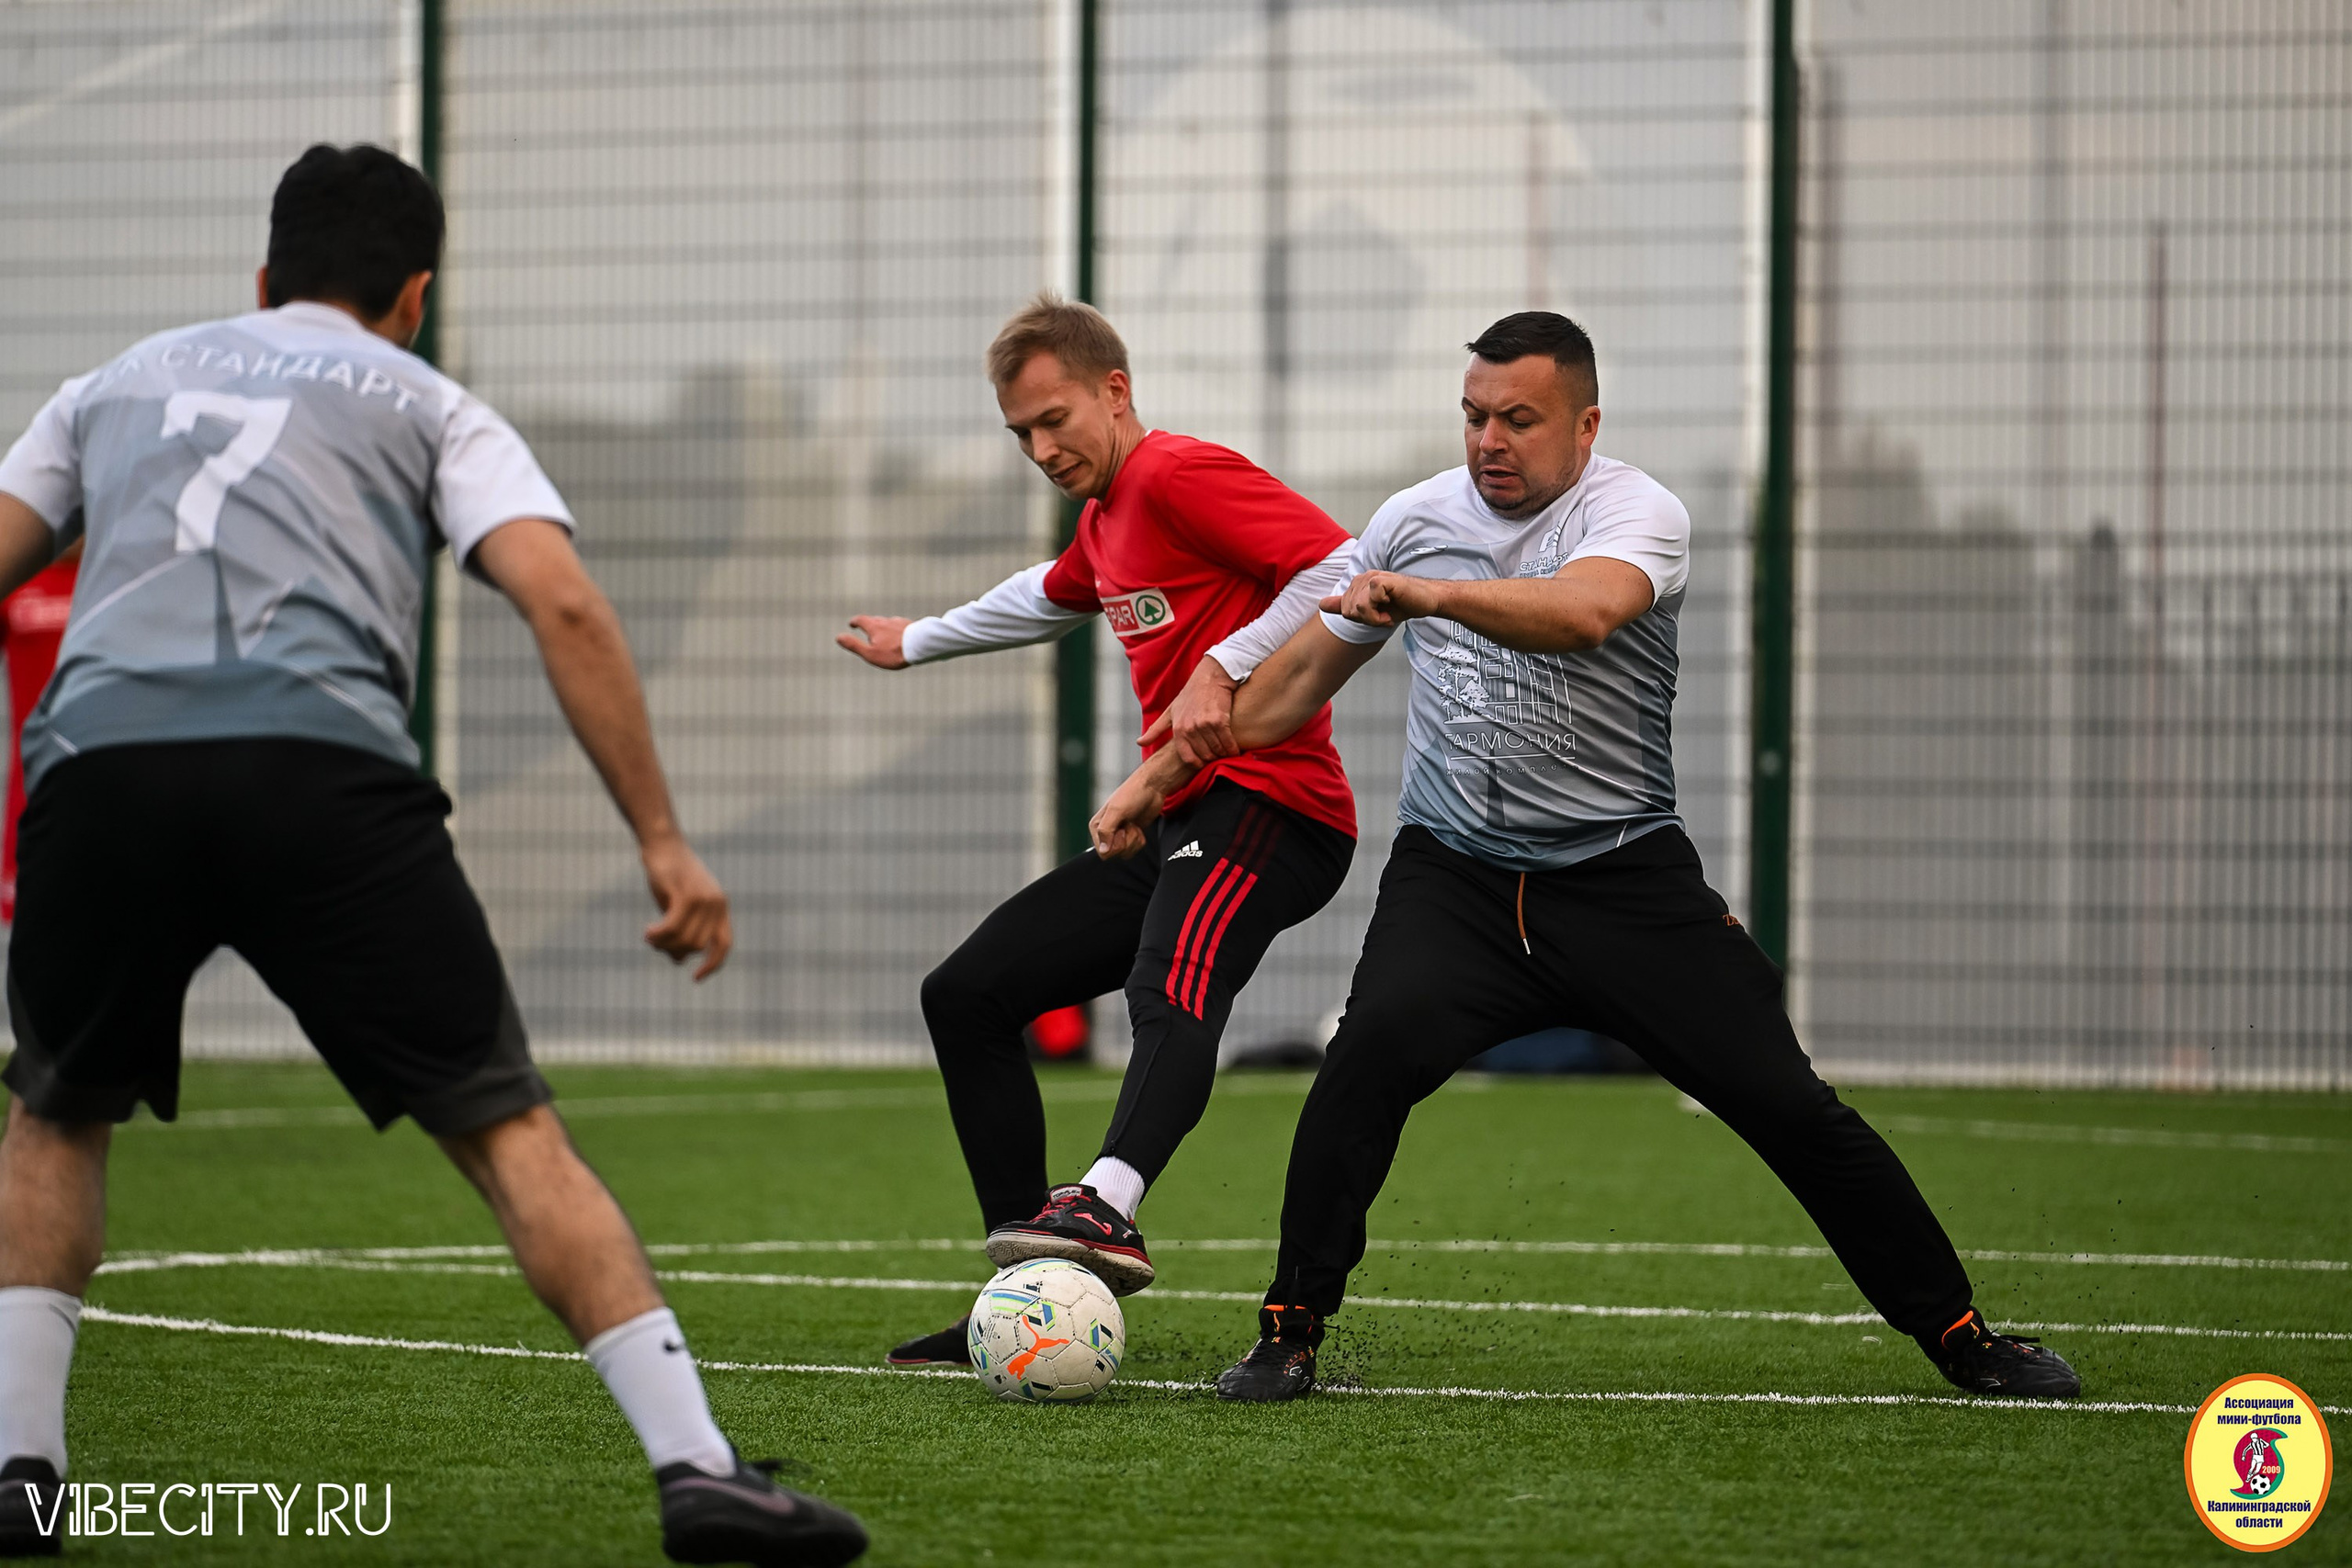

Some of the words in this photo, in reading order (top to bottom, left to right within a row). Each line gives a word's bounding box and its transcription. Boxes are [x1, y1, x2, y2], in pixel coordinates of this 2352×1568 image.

[161, 344, 423, 413] СТАНДАРТ
[161, 390, 292, 551] 7
[1444, 731, 1577, 750] ГАРМОНИЯ
[1496, 764, 1576, 775] КОМПЛЕ
